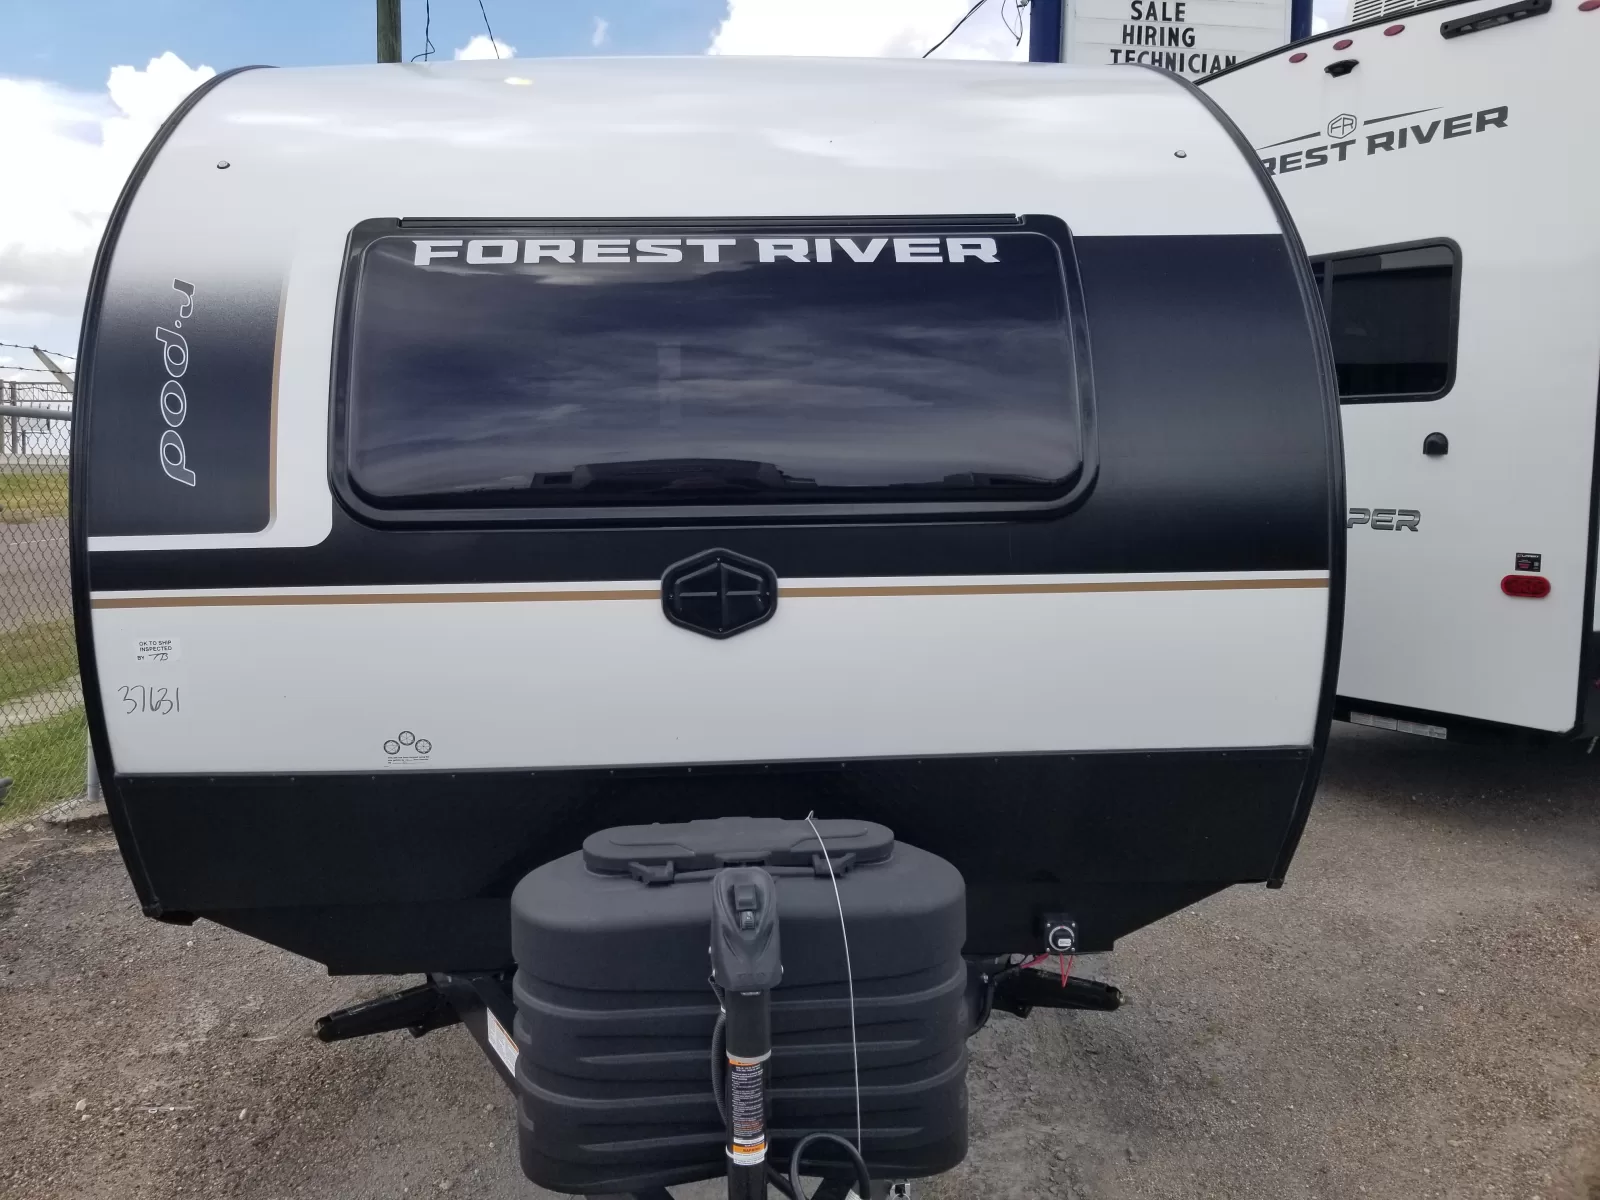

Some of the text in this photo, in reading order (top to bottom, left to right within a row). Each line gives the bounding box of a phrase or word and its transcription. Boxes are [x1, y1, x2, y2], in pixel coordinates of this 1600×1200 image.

[1130, 0, 1186, 22] SALE
[1122, 24, 1196, 48] HIRING
[1366, 105, 1509, 156] RIVER
[412, 237, 1001, 266] FOREST RIVER
